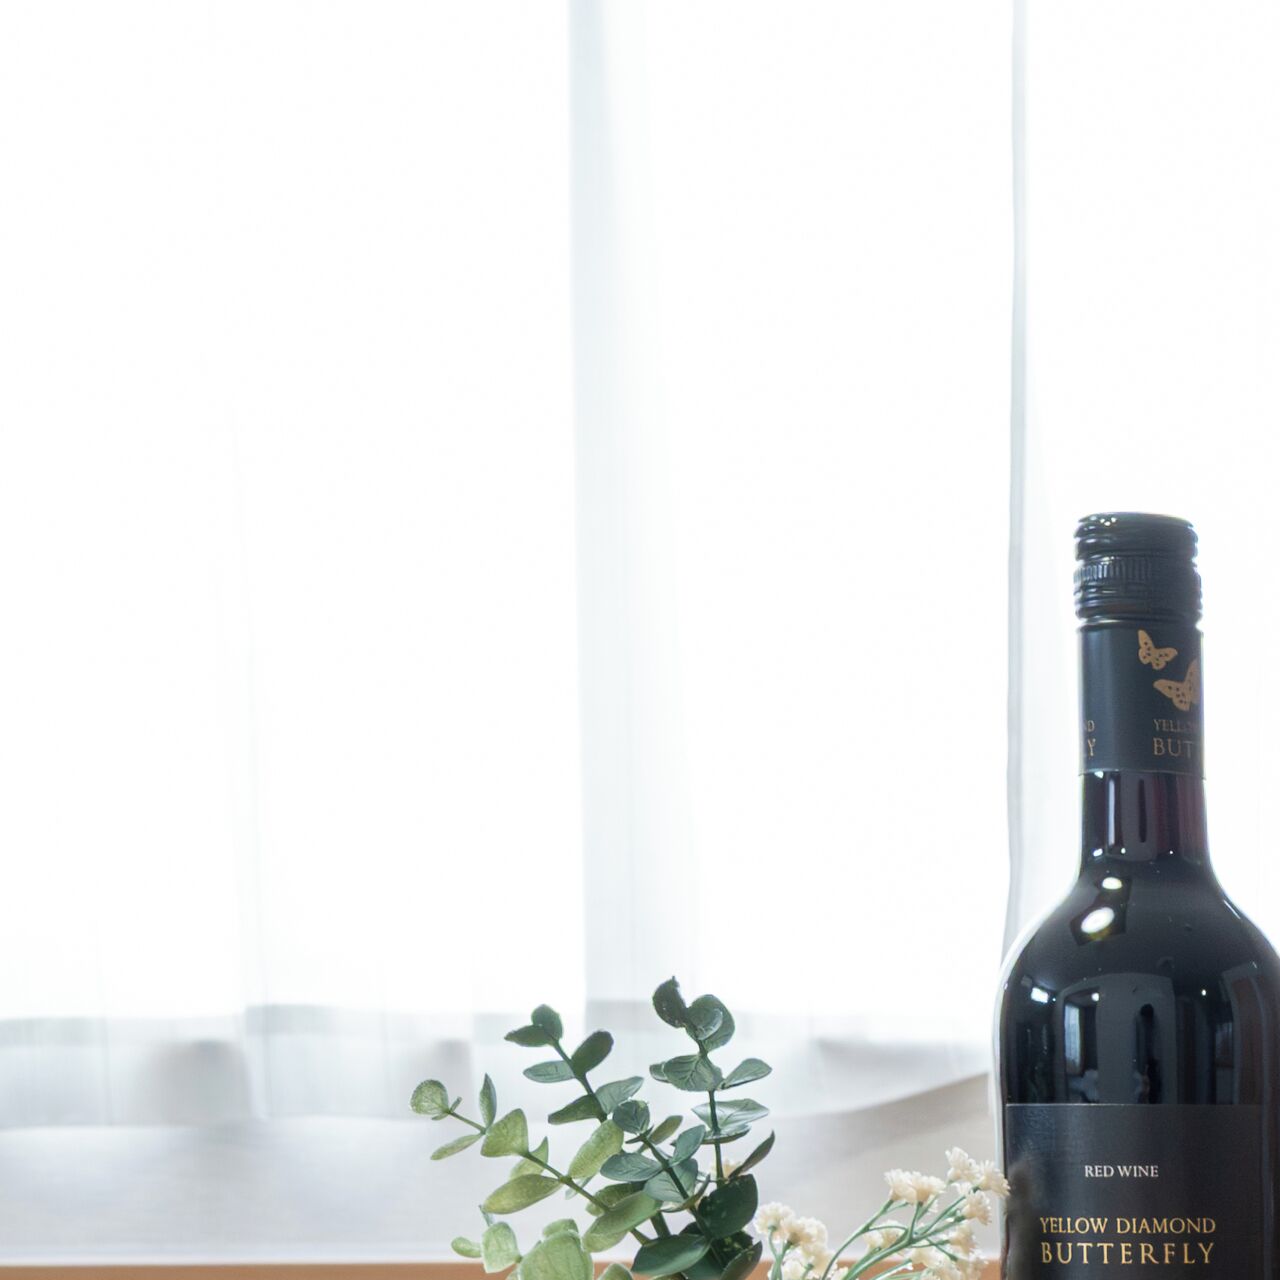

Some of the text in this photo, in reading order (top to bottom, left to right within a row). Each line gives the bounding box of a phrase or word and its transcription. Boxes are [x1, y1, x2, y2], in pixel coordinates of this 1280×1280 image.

[1084, 1164, 1159, 1177] RED WINE
[1039, 1216, 1216, 1234] YELLOW DIAMOND
[1040, 1241, 1214, 1264] BUTTERFLY
